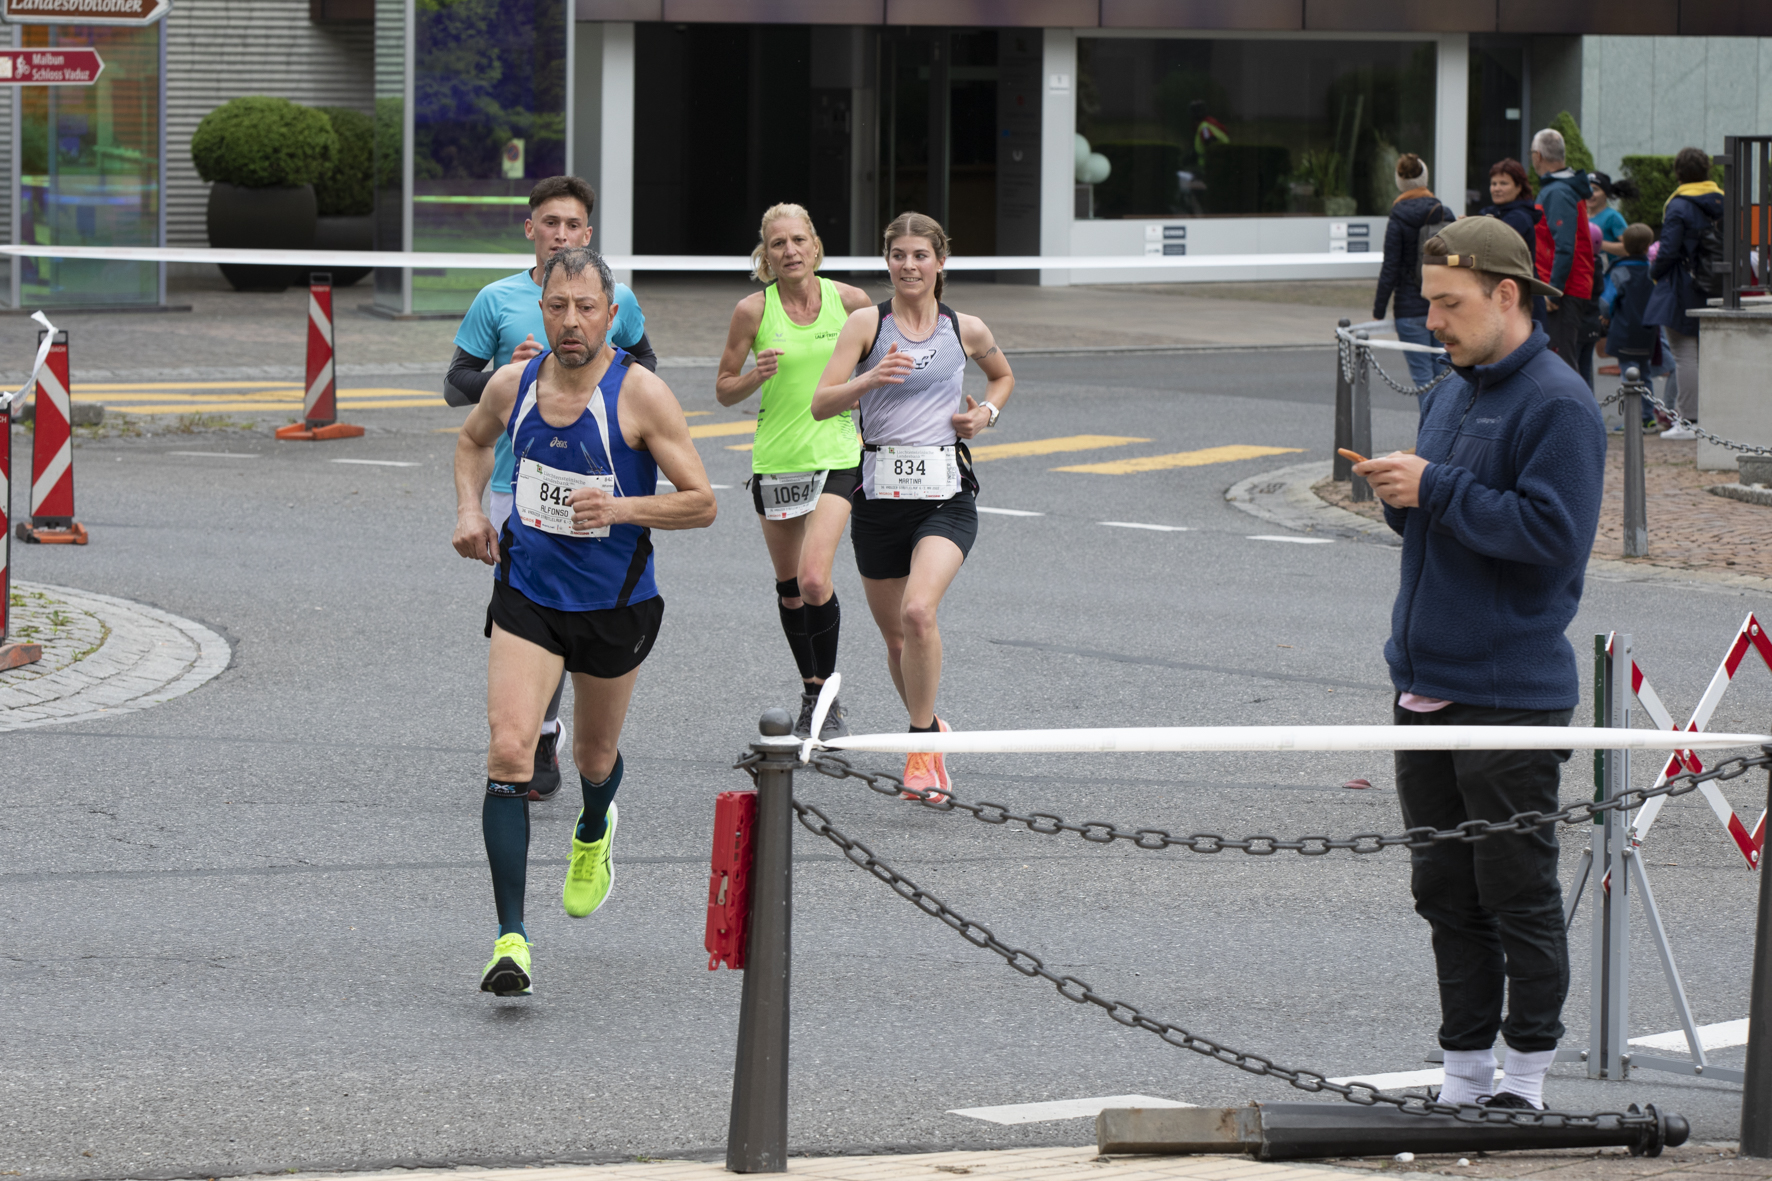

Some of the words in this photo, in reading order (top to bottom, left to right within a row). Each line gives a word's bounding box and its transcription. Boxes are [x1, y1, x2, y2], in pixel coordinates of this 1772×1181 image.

[10, 0, 143, 12] Landesbibliothek
[32, 53, 65, 66] Malbun
[32, 68, 63, 81] Schloss
[64, 68, 90, 81] Vaduz
[893, 459, 926, 476] 834
[540, 482, 572, 508] 842
[773, 484, 810, 505] 1064
[540, 505, 569, 518] ALFONSO
